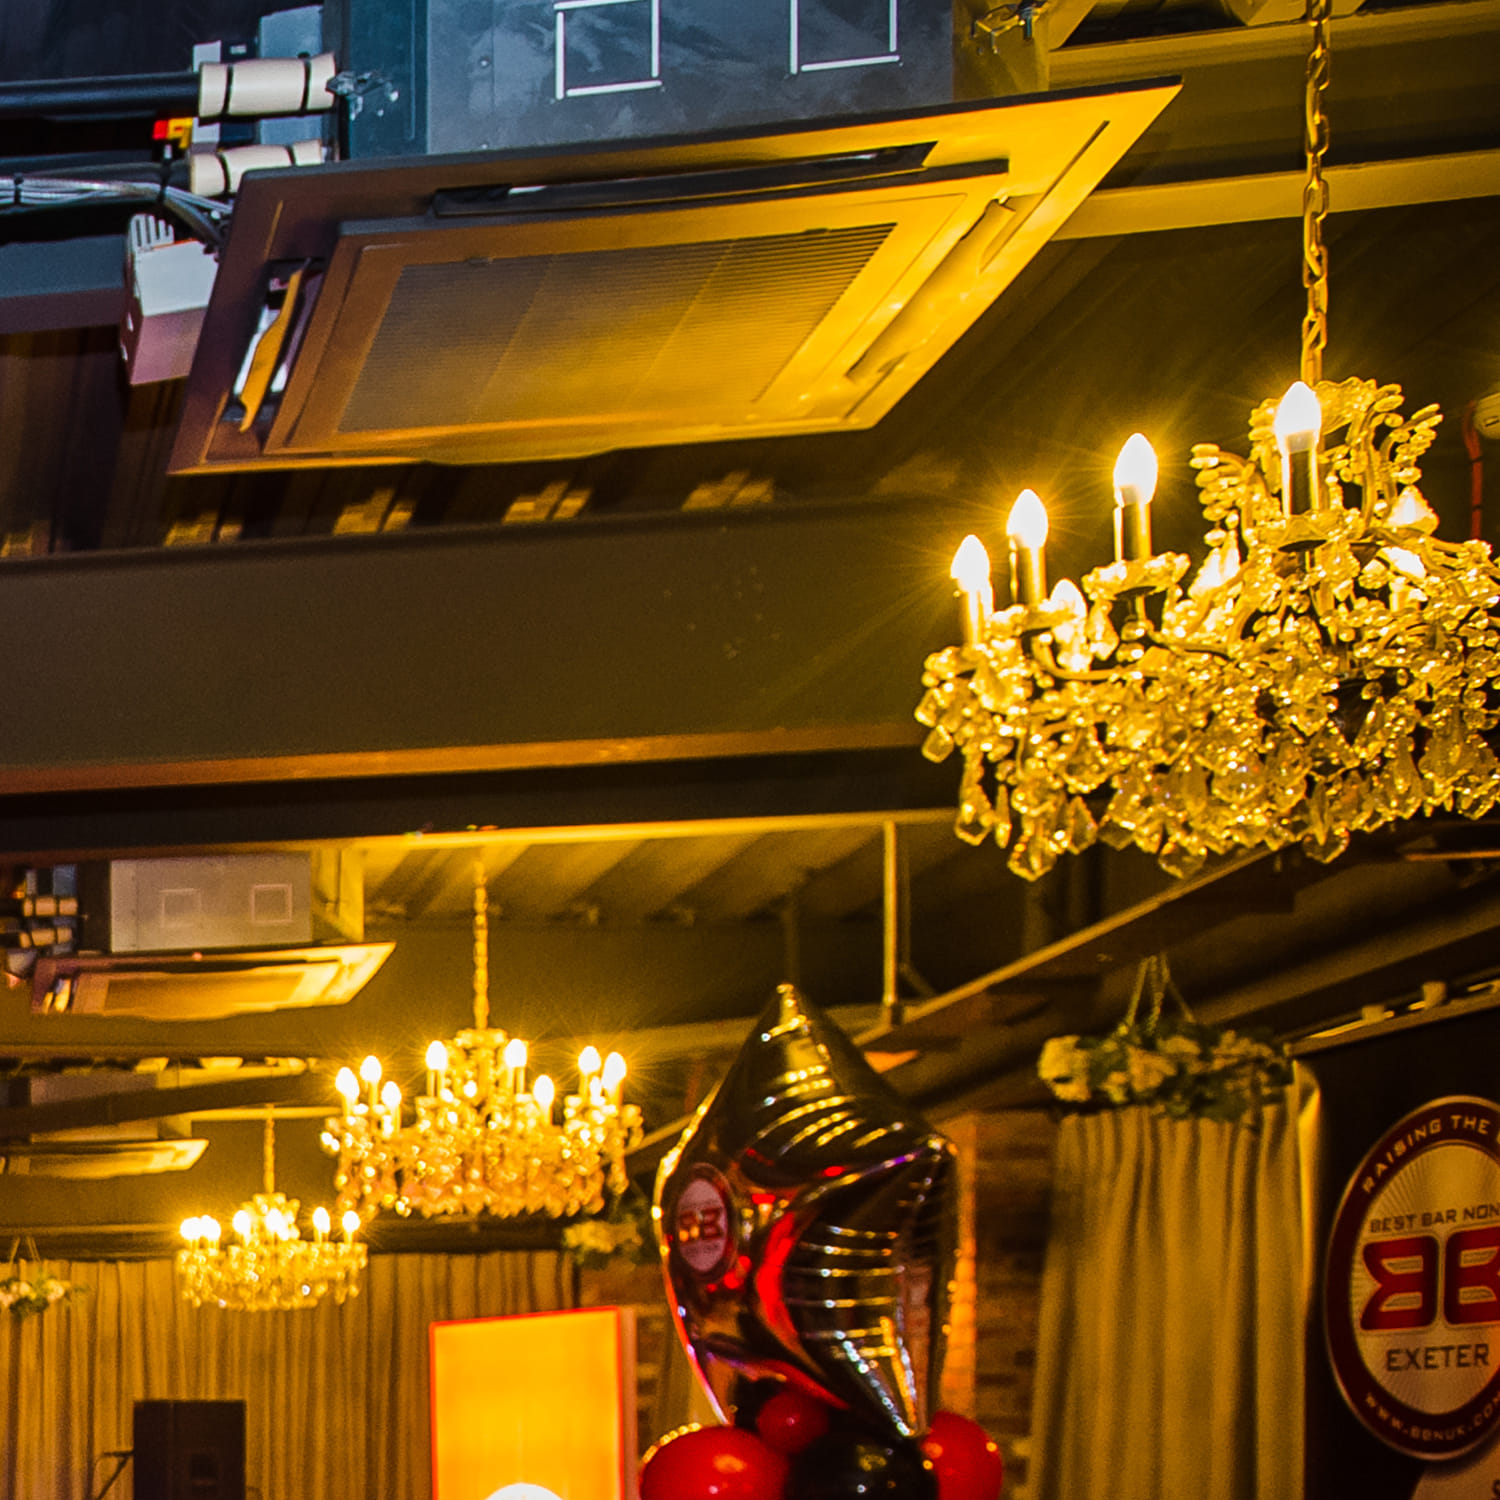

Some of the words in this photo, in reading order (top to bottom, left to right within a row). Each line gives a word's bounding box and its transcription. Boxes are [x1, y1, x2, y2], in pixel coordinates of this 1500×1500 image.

[1362, 1117, 1443, 1193] RAISING
[1450, 1114, 1491, 1136] THE
[1370, 1213, 1416, 1233] BEST
[1421, 1209, 1457, 1227] BAR
[1385, 1343, 1489, 1372] EXETER
